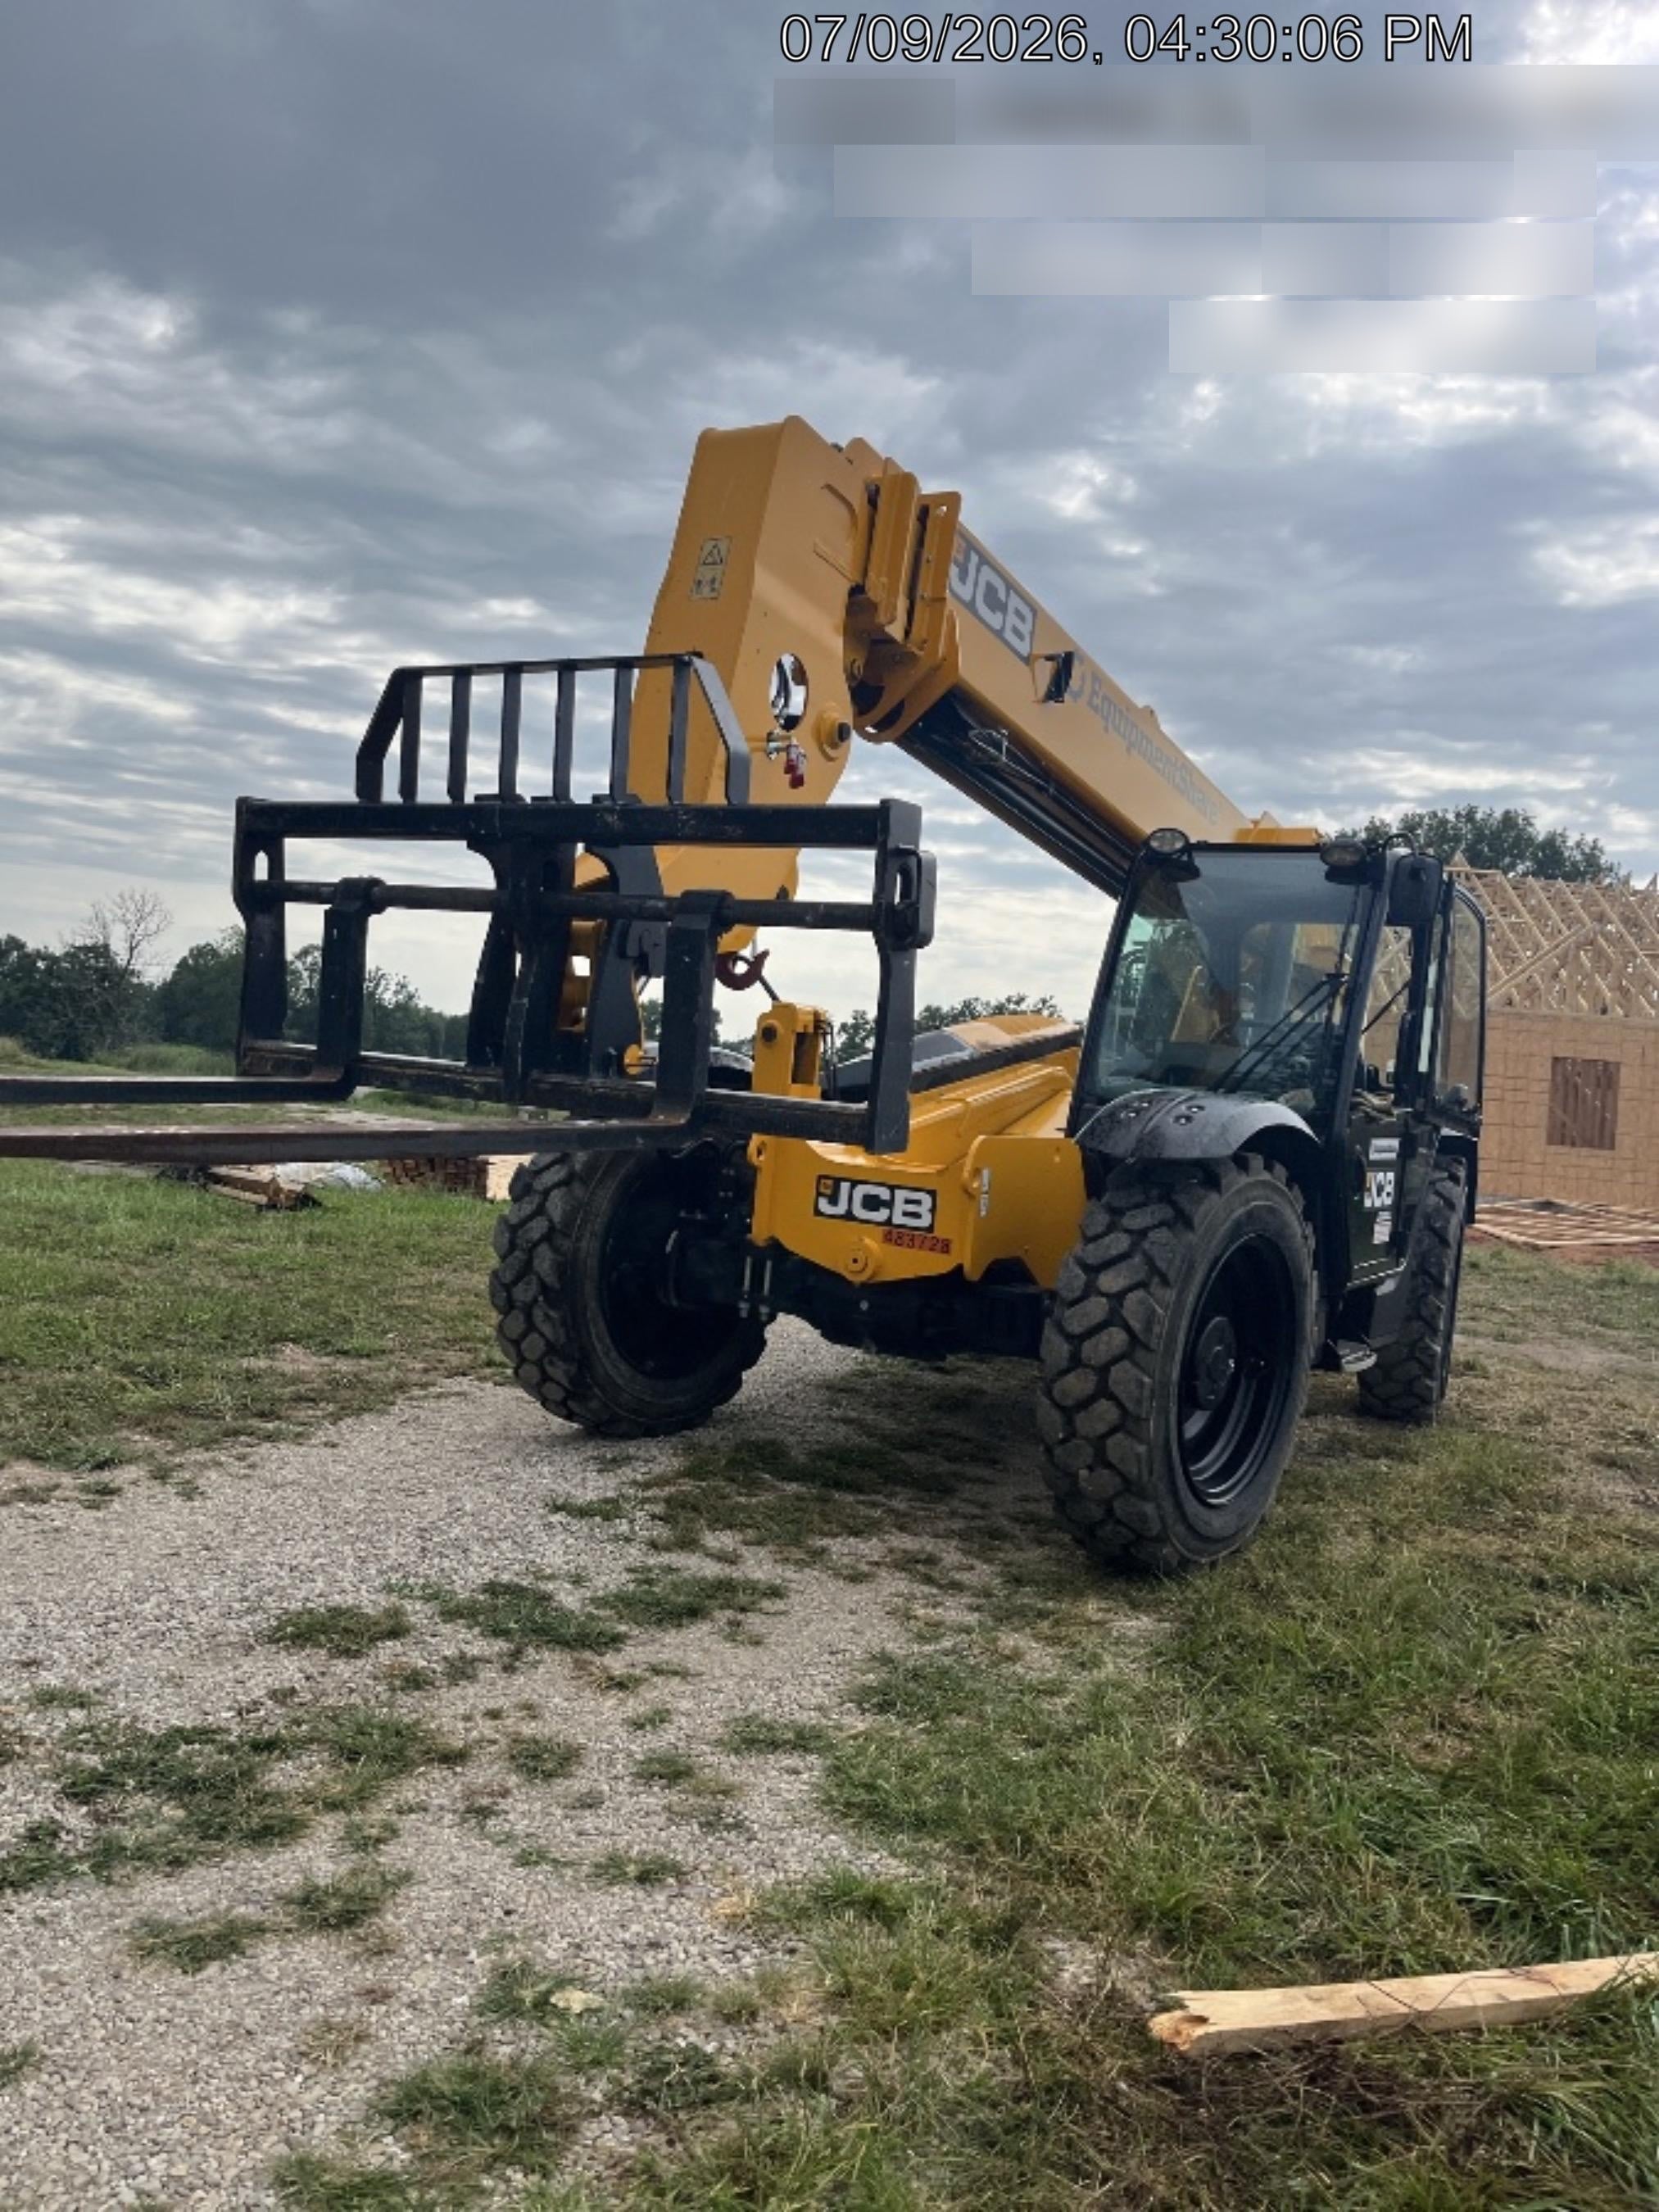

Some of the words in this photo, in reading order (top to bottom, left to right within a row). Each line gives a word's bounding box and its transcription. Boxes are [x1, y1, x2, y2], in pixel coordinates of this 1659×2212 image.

[949, 550, 1035, 658] JCB
[818, 1181, 933, 1227] JCB
[1363, 1171, 1395, 1208] JCB
